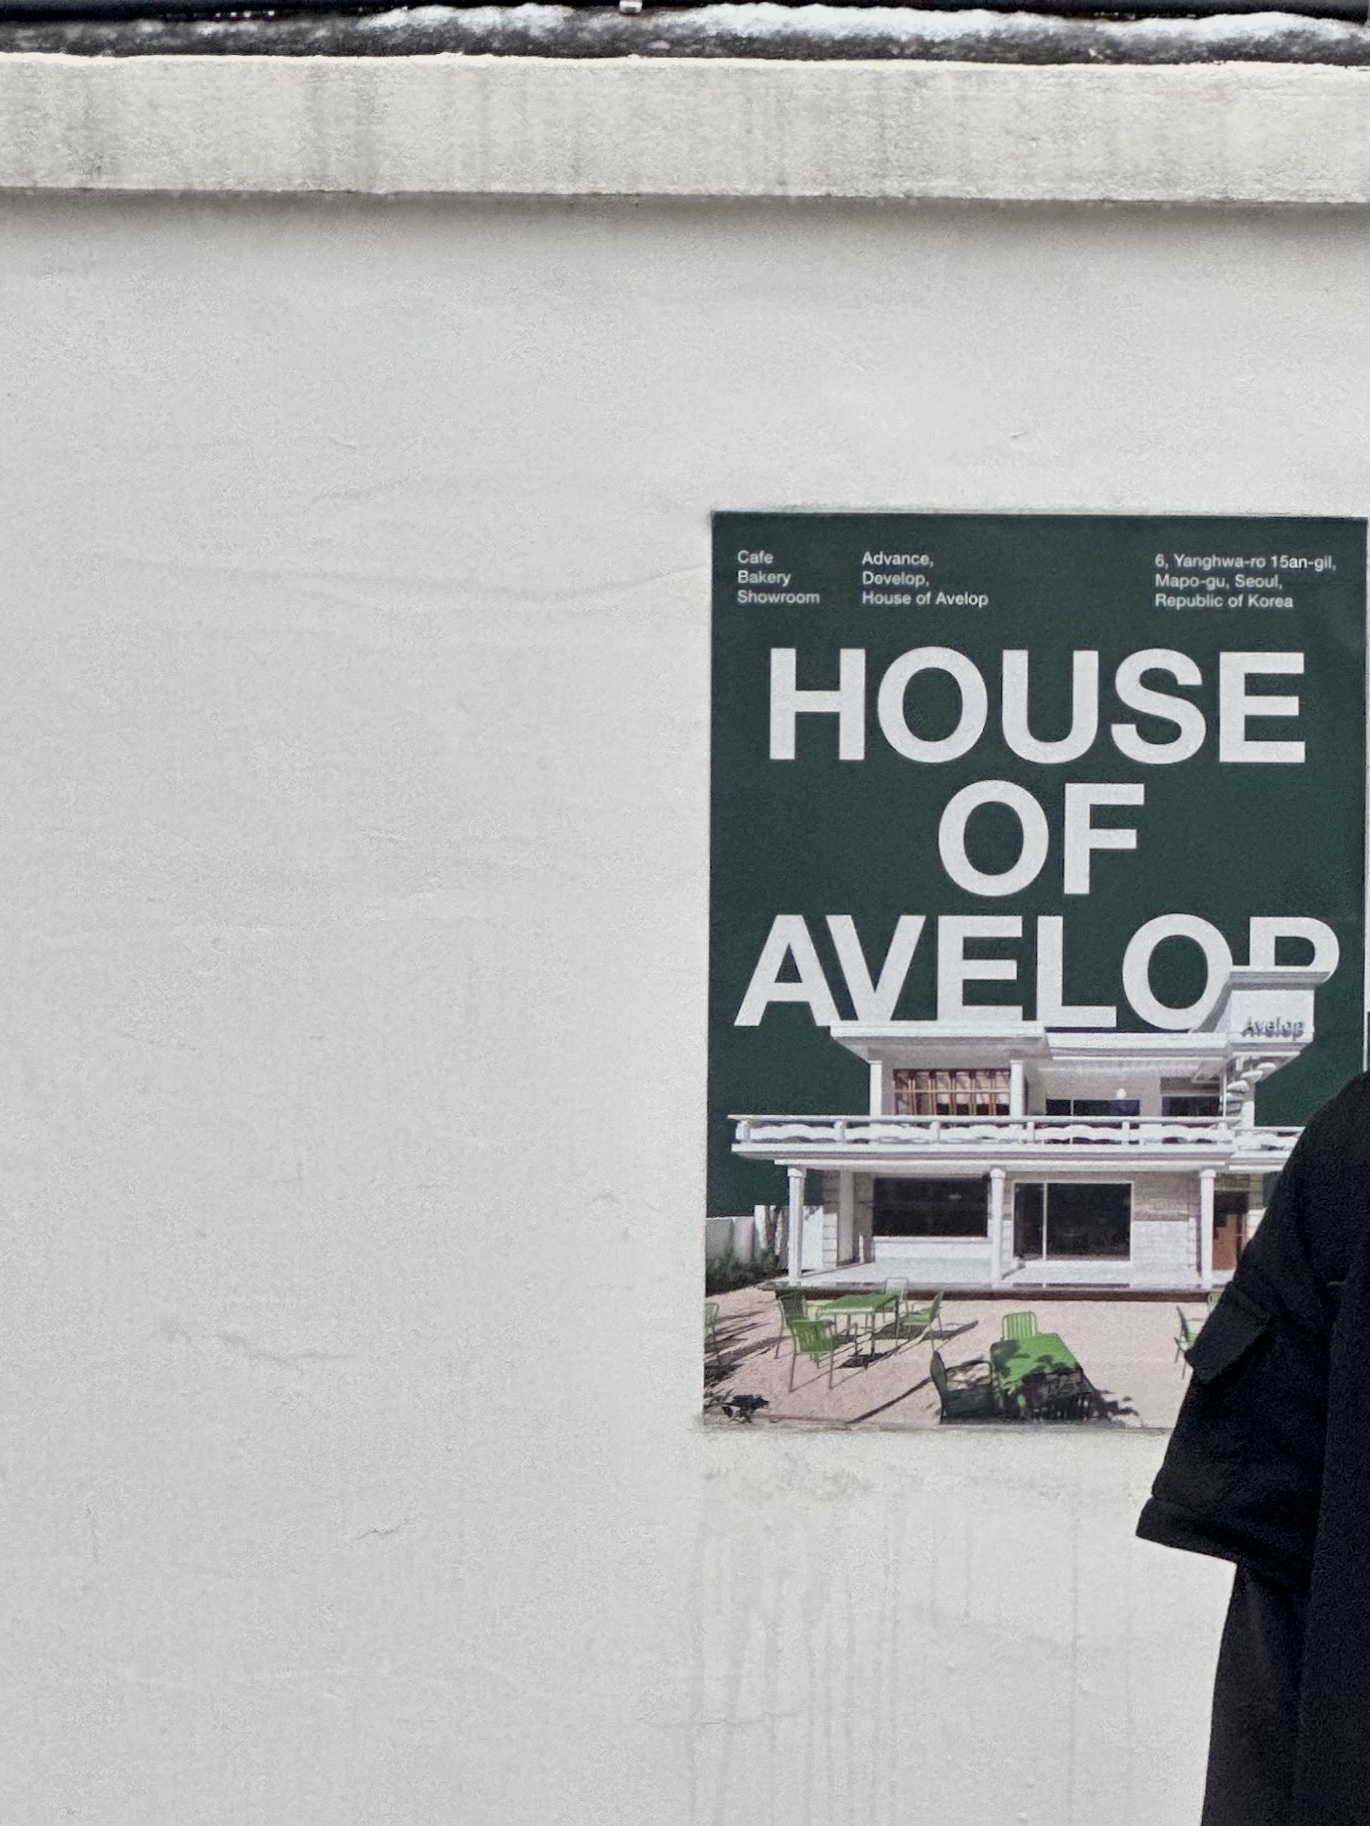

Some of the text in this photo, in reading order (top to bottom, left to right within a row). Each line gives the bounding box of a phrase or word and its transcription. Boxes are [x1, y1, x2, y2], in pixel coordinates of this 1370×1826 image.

[737, 550, 774, 564] Cafe
[862, 551, 934, 568] Advance,
[1155, 554, 1337, 572] 6, Yanghwa-ro 15an-gil,
[737, 570, 792, 587] Bakery
[862, 571, 930, 588] Develop,
[1155, 574, 1283, 590] Mapo-gu, Seoul,
[737, 590, 821, 605] Showroom
[862, 590, 989, 608] House of Avelop
[1155, 593, 1294, 610] Republic of Korea
[769, 646, 1306, 765] HOUSE
[938, 779, 1145, 897] OF
[734, 912, 1340, 1031] AVELOP
